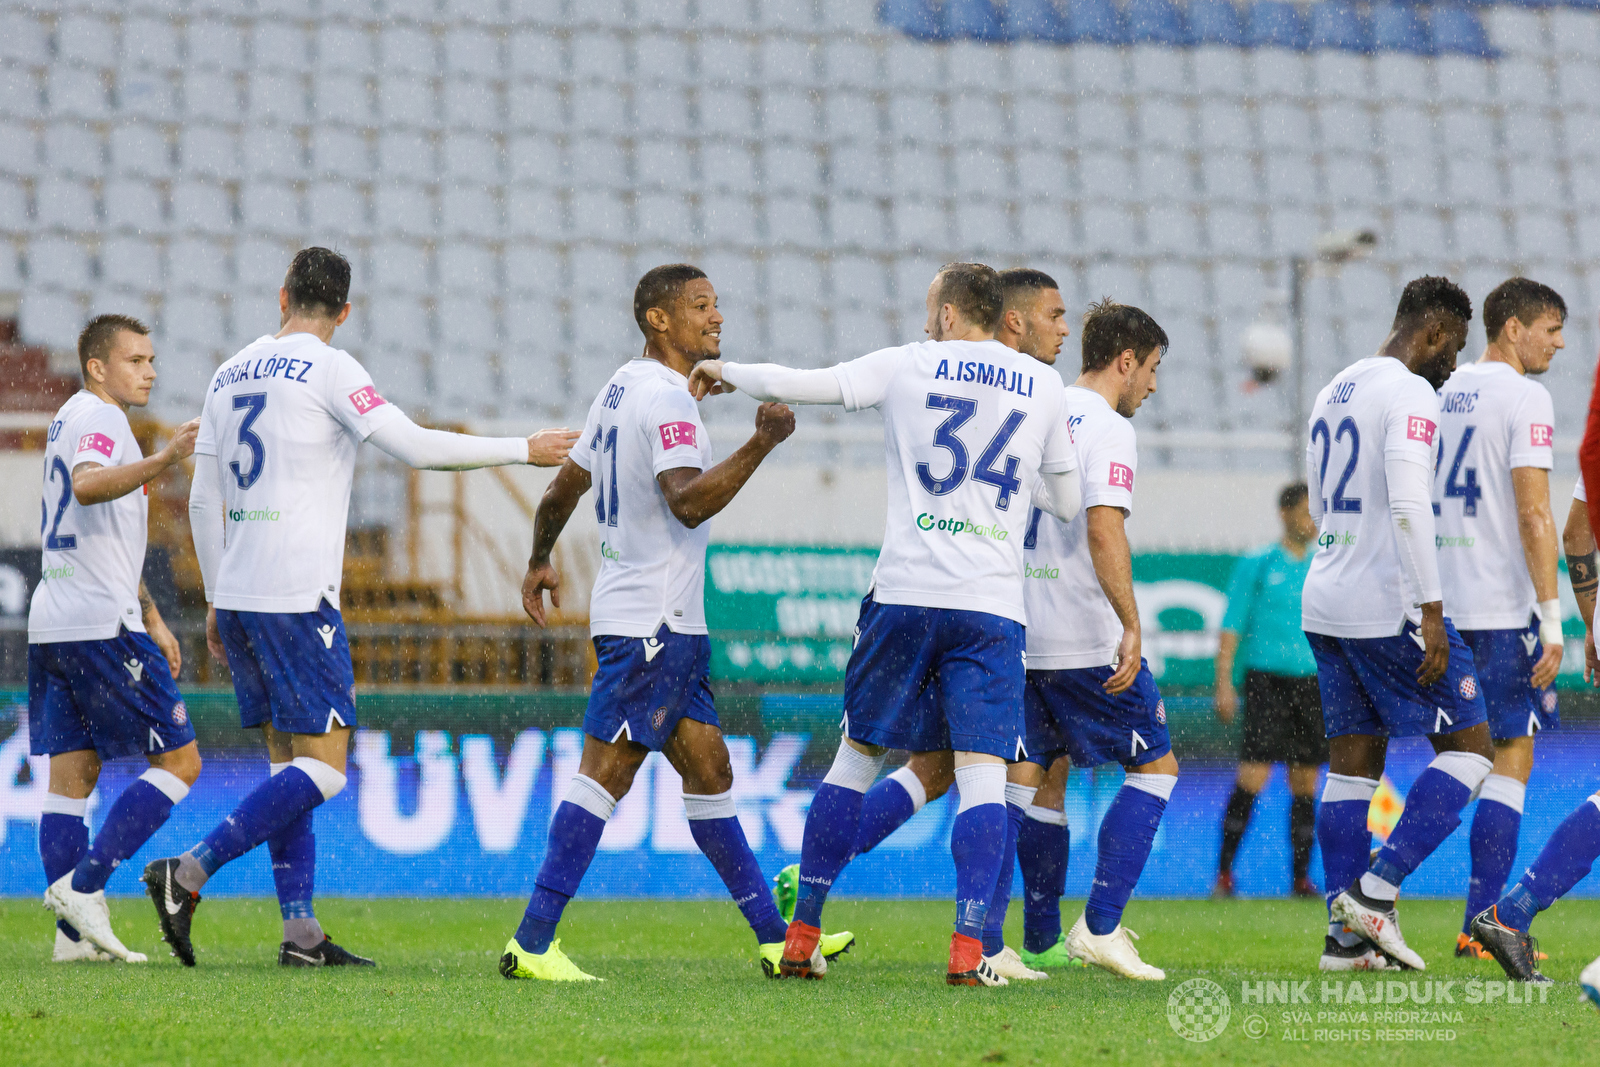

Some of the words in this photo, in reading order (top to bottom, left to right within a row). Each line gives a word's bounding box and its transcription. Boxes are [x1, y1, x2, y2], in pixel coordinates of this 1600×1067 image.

[213, 360, 252, 393] BORJA
[253, 353, 313, 383] LÓPEZ
[935, 359, 1034, 398] A.ISMAJLI
[1327, 382, 1356, 405] AID
[229, 392, 267, 490] 3
[916, 393, 1027, 511] 34
[590, 423, 619, 528] 11
[1311, 416, 1362, 514] 22
[937, 517, 1008, 541] otpbanka
[800, 875, 833, 886] hajduk
